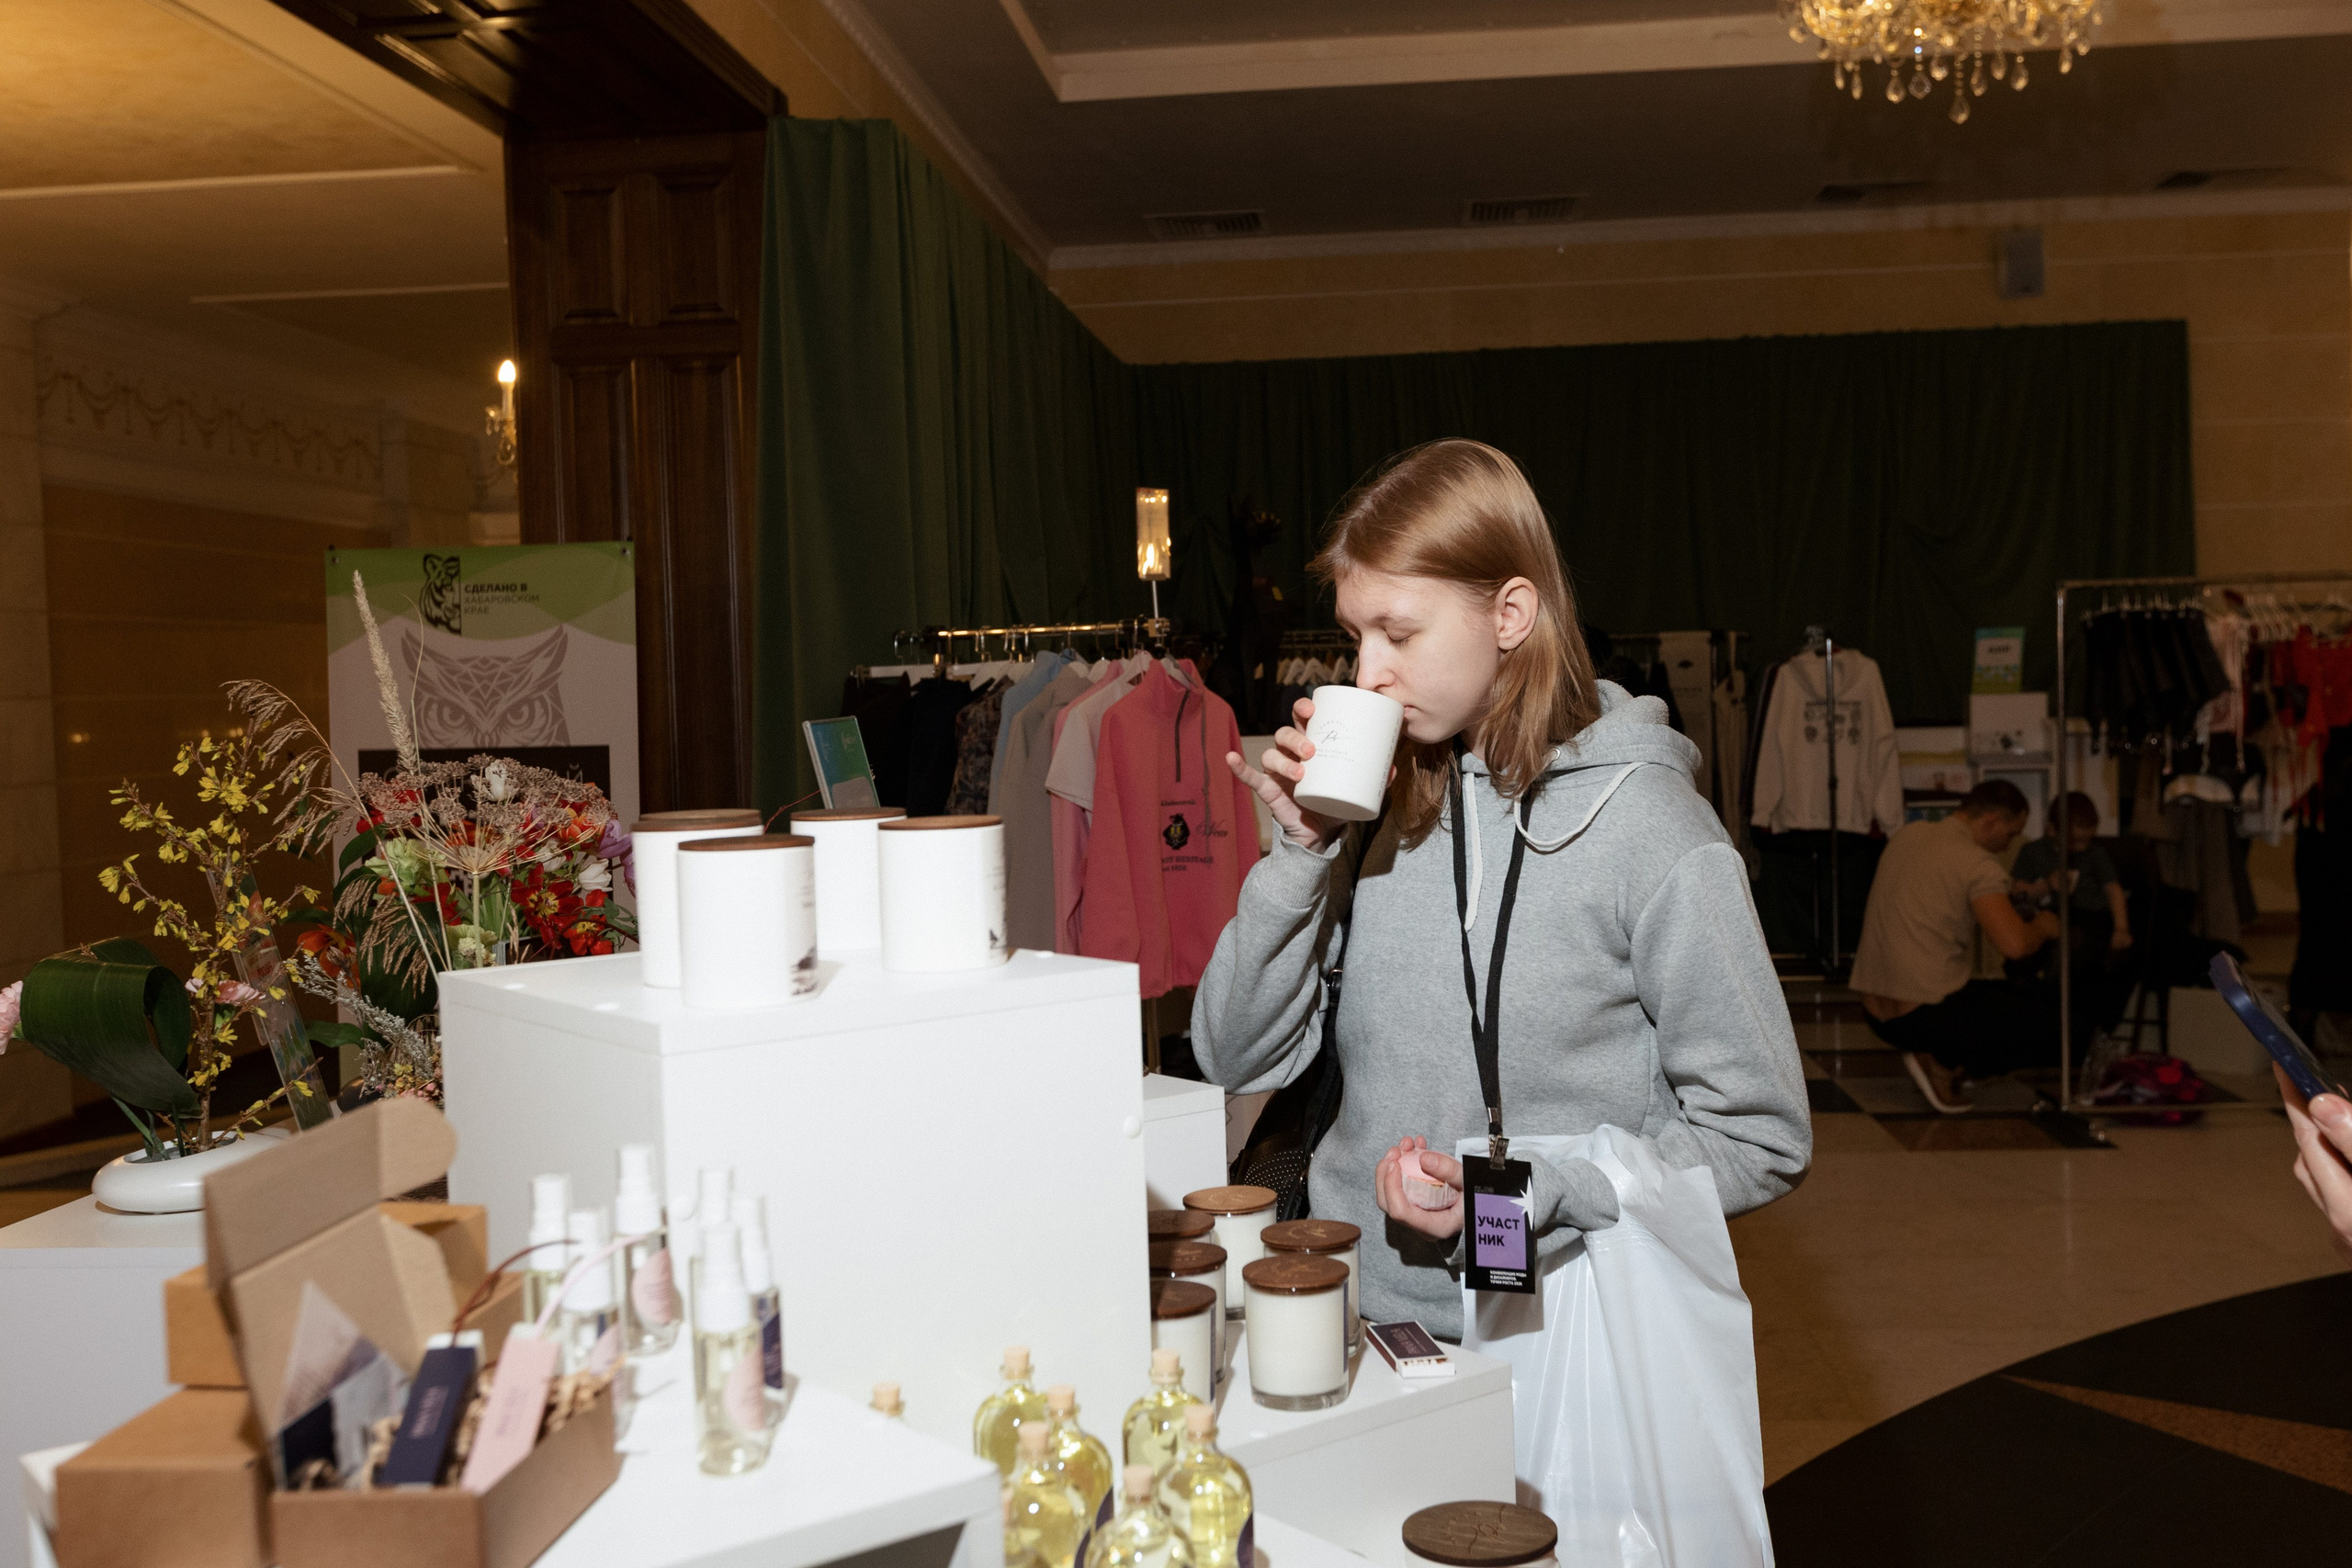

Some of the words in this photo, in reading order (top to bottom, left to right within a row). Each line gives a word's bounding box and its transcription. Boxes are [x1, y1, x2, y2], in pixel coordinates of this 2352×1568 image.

[465, 583, 517, 593] СДЕЛАНО
[521, 583, 527, 592] В
[465, 594, 539, 604] ХАБАРОВСКОМ
[464, 606, 489, 615] КРАЕ
[1477, 1215, 1520, 1230] УЧАСТ
[1478, 1234, 1505, 1247] НИК
